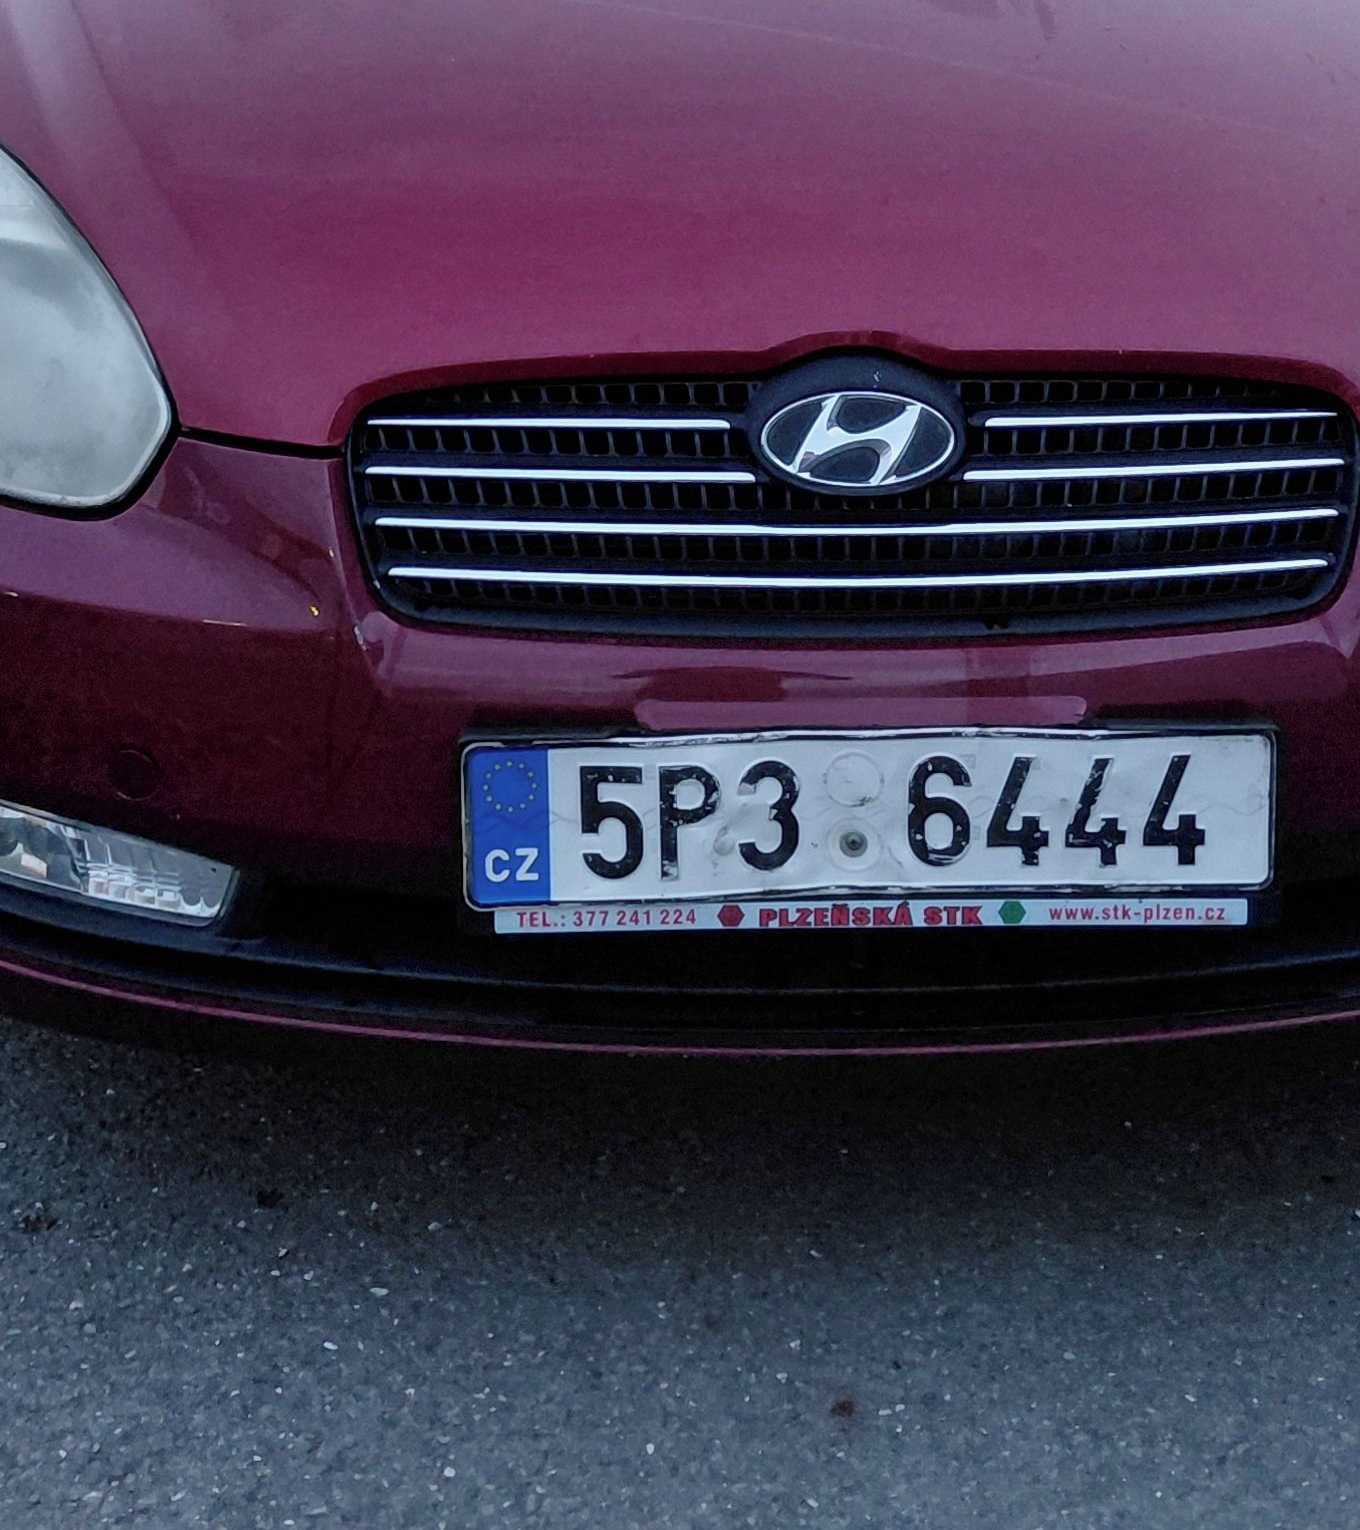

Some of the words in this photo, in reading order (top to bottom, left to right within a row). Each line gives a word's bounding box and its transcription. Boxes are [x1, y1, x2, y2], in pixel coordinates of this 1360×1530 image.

[578, 759, 801, 882] 5P3
[906, 753, 1207, 868] 6444
[485, 846, 540, 882] CZ
[516, 910, 566, 928] TEL.:
[572, 909, 609, 927] 377
[615, 908, 652, 926] 241
[659, 908, 697, 925] 224
[758, 900, 913, 928] PLZEŇSKÁ
[922, 905, 984, 926] STK
[1048, 902, 1227, 924] www.stk-plzen.cz
